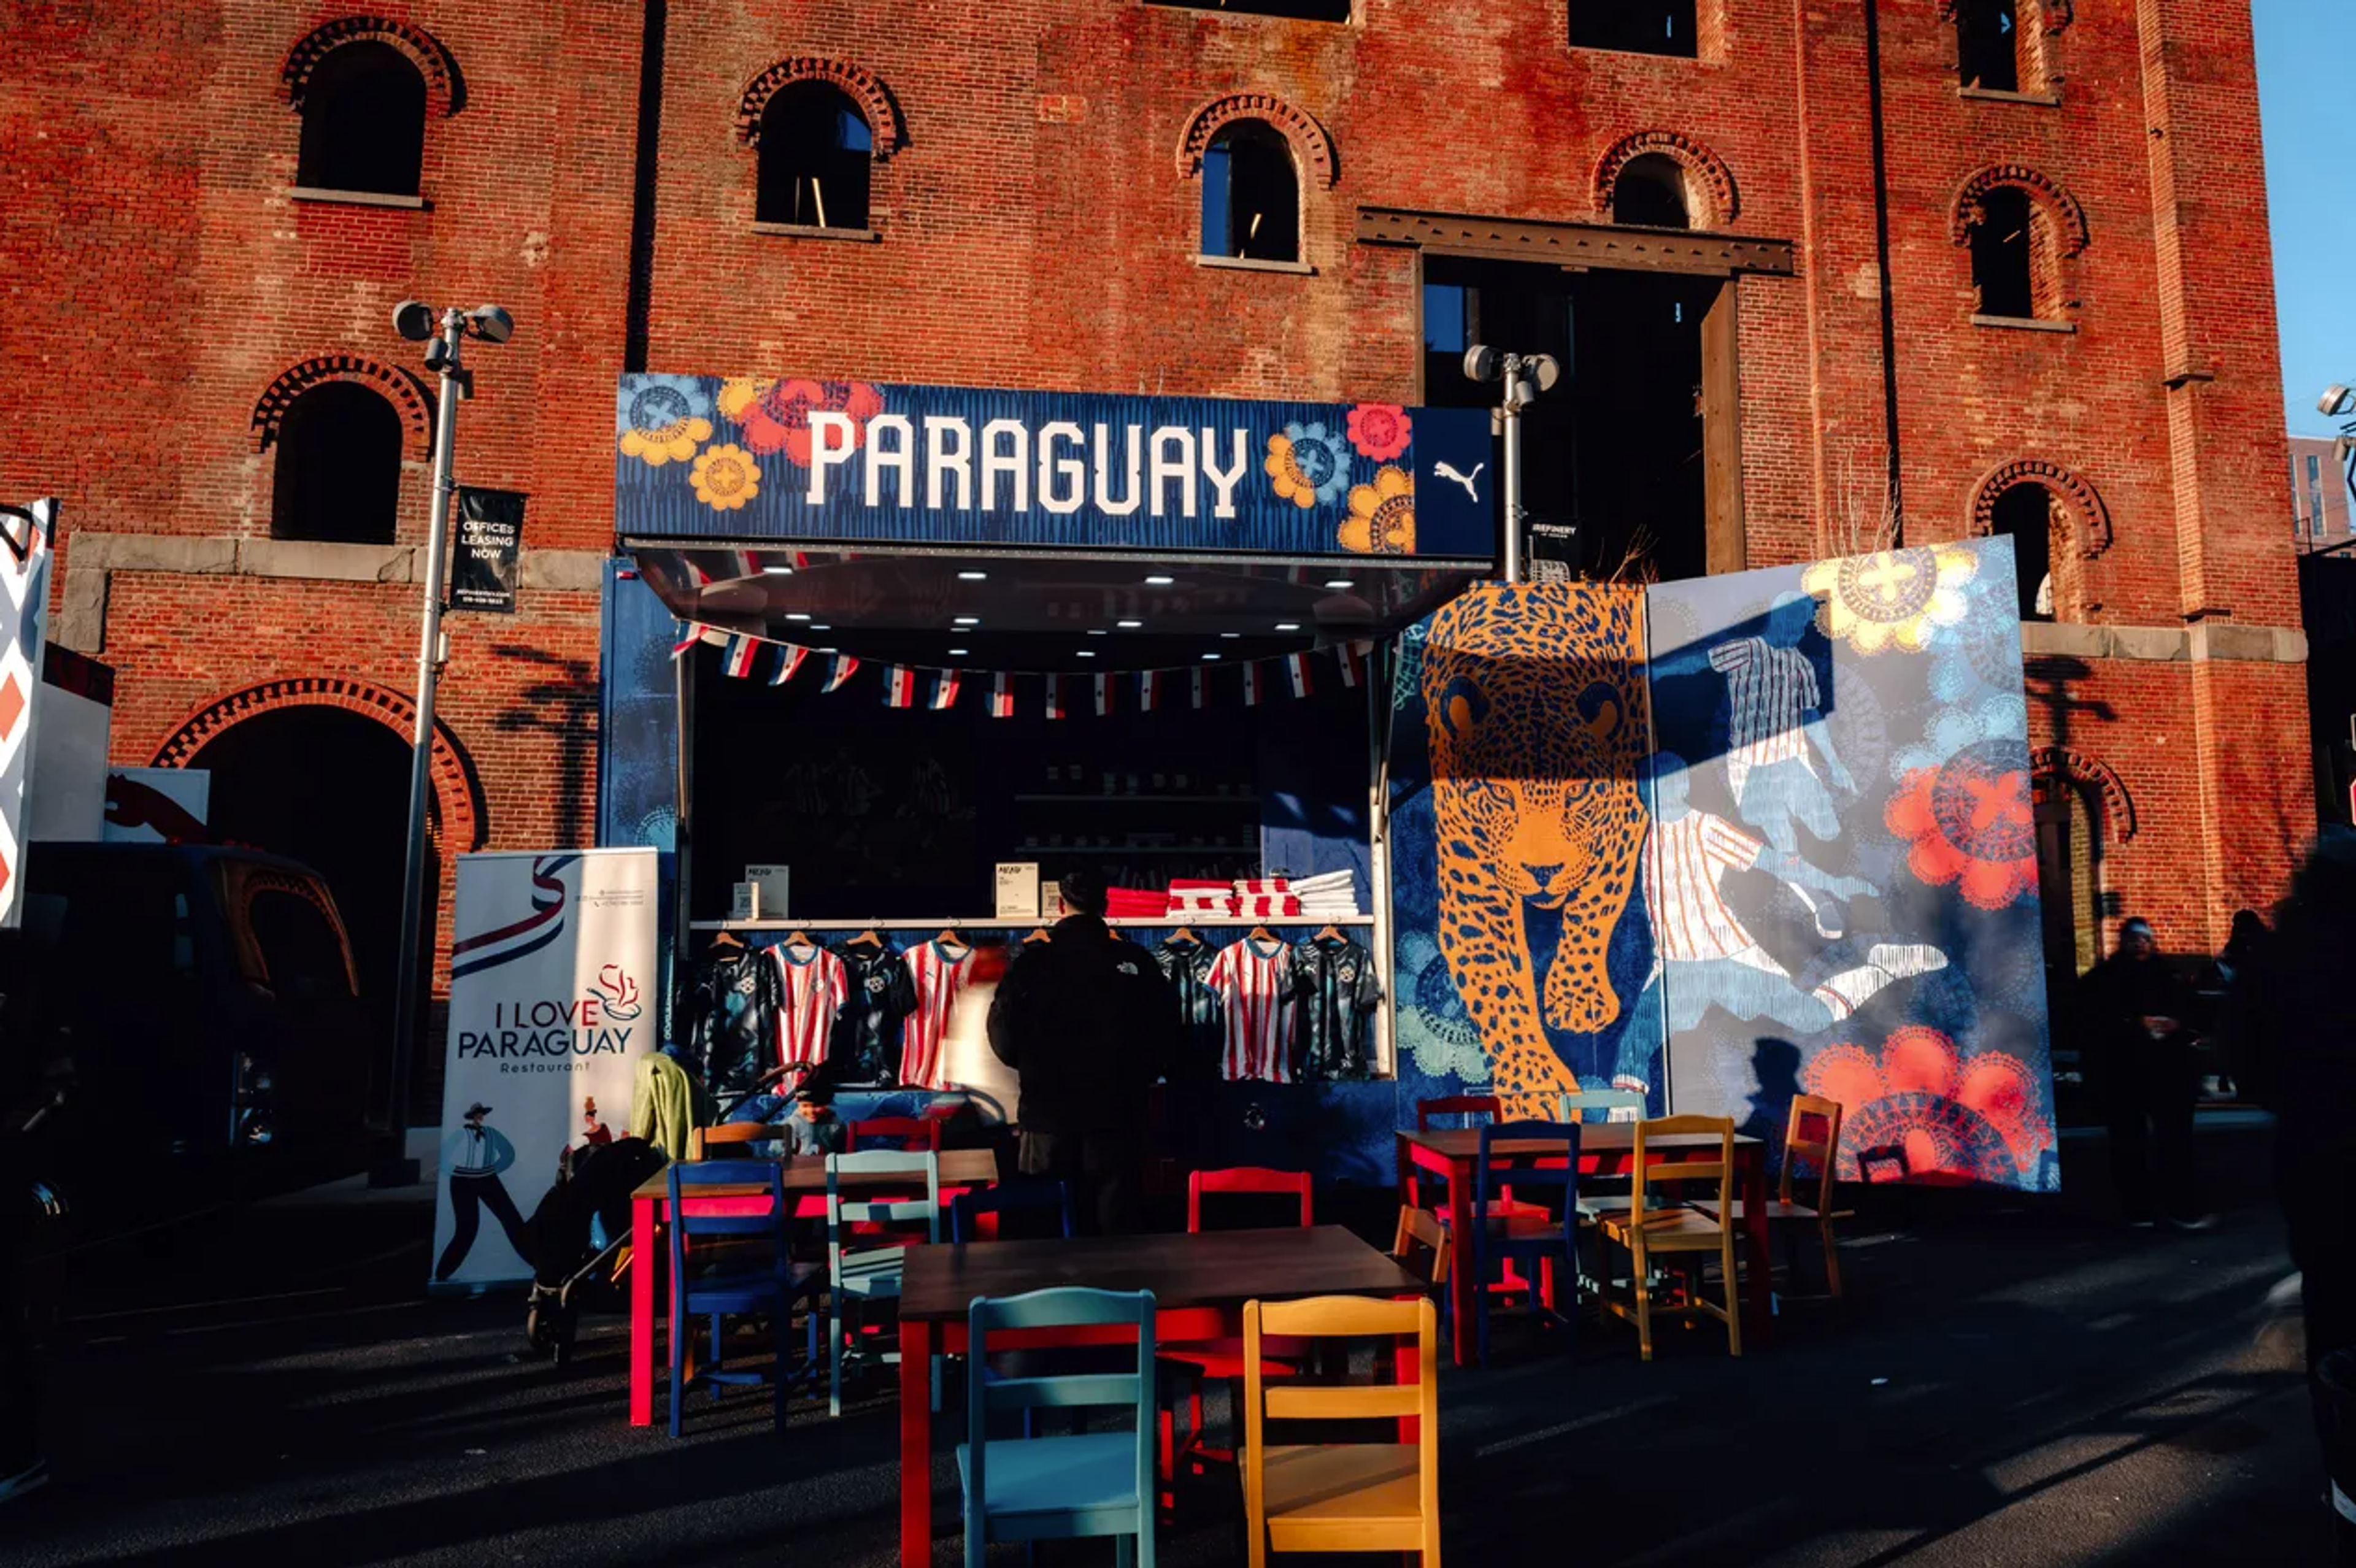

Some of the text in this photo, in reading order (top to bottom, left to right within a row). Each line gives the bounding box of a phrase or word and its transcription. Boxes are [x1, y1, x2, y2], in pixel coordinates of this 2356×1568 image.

[807, 410, 1247, 517] PARAGUAY
[463, 521, 514, 534] OFFICES
[461, 535, 514, 547] LEASING
[471, 548, 502, 559] NOW
[496, 1001, 599, 1028] I LOVE
[458, 1027, 633, 1058] PARAGUAY
[501, 1062, 590, 1074] Restaurant
